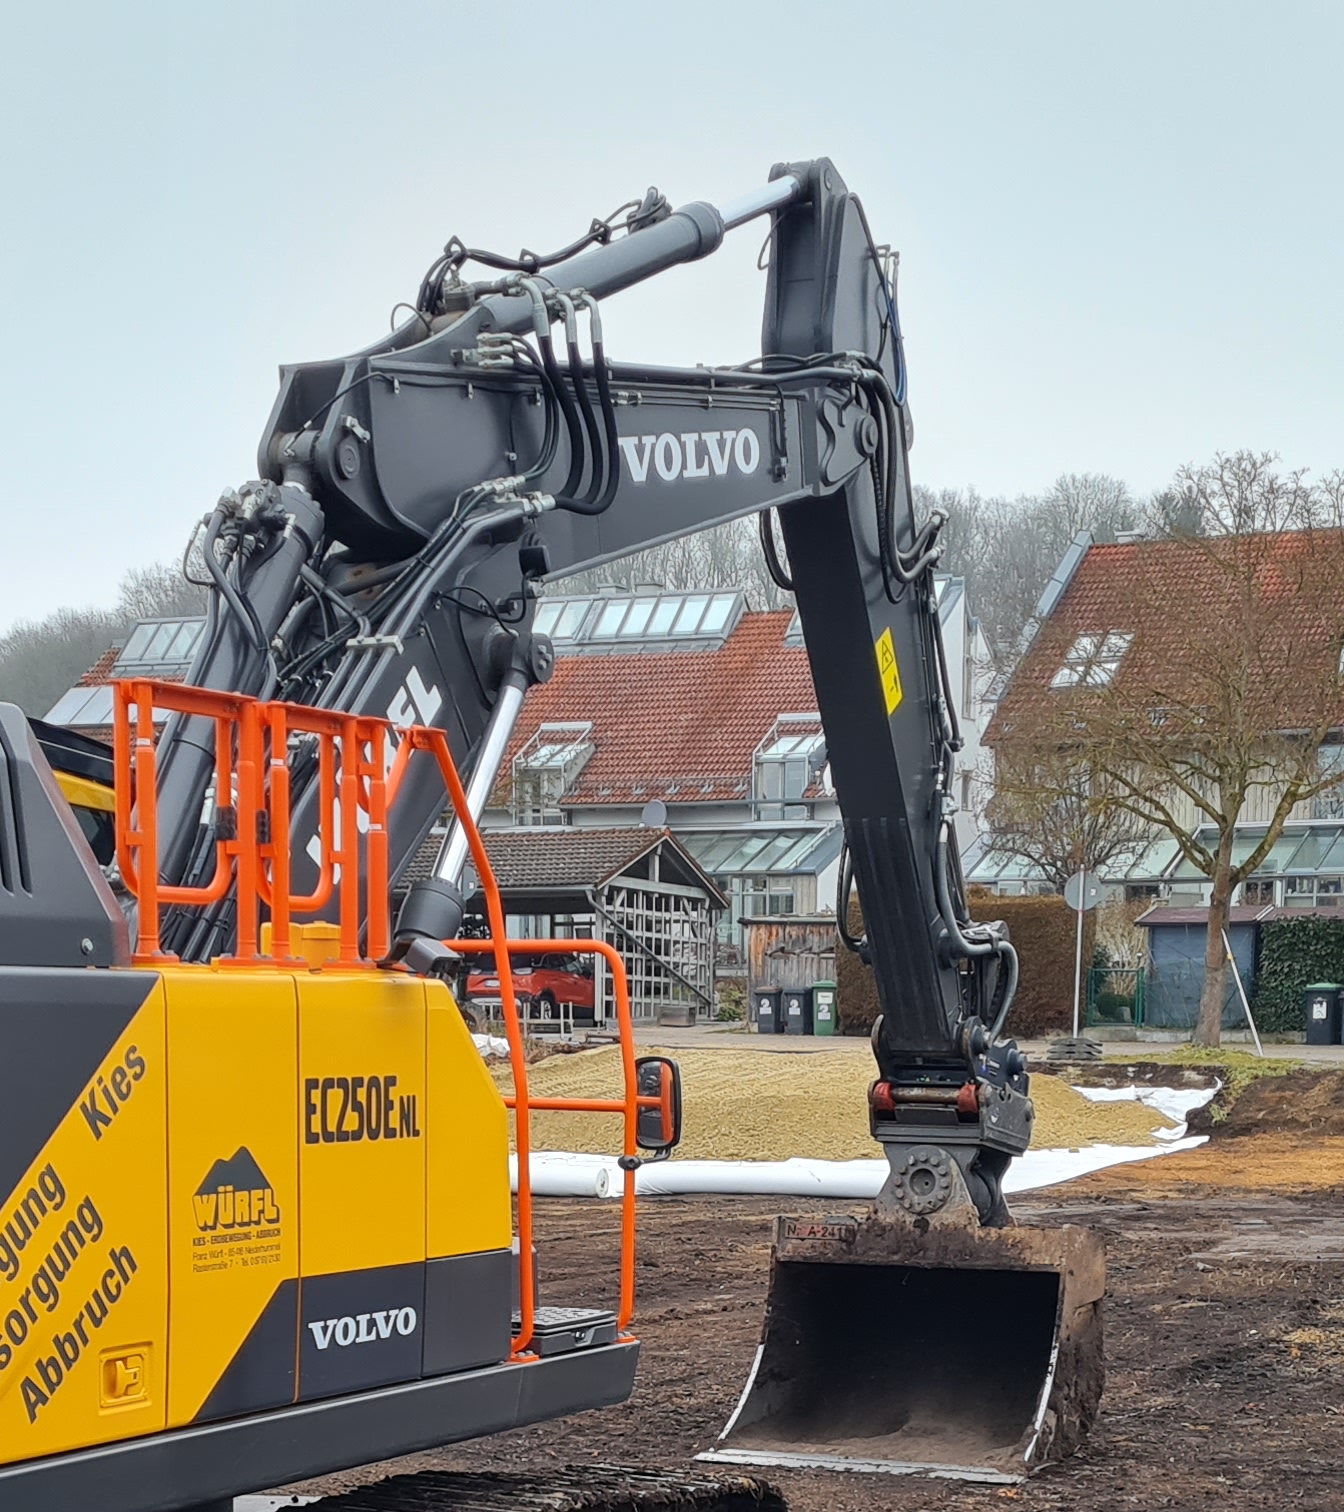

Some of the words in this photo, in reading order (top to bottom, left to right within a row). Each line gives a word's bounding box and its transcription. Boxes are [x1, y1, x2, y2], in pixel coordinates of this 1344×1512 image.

[617, 428, 760, 482] VOLVO
[79, 1043, 146, 1141] Kies
[192, 1185, 280, 1231] WÜRFL
[19, 1245, 138, 1424] Abbruch
[308, 1306, 417, 1350] VOLVO
